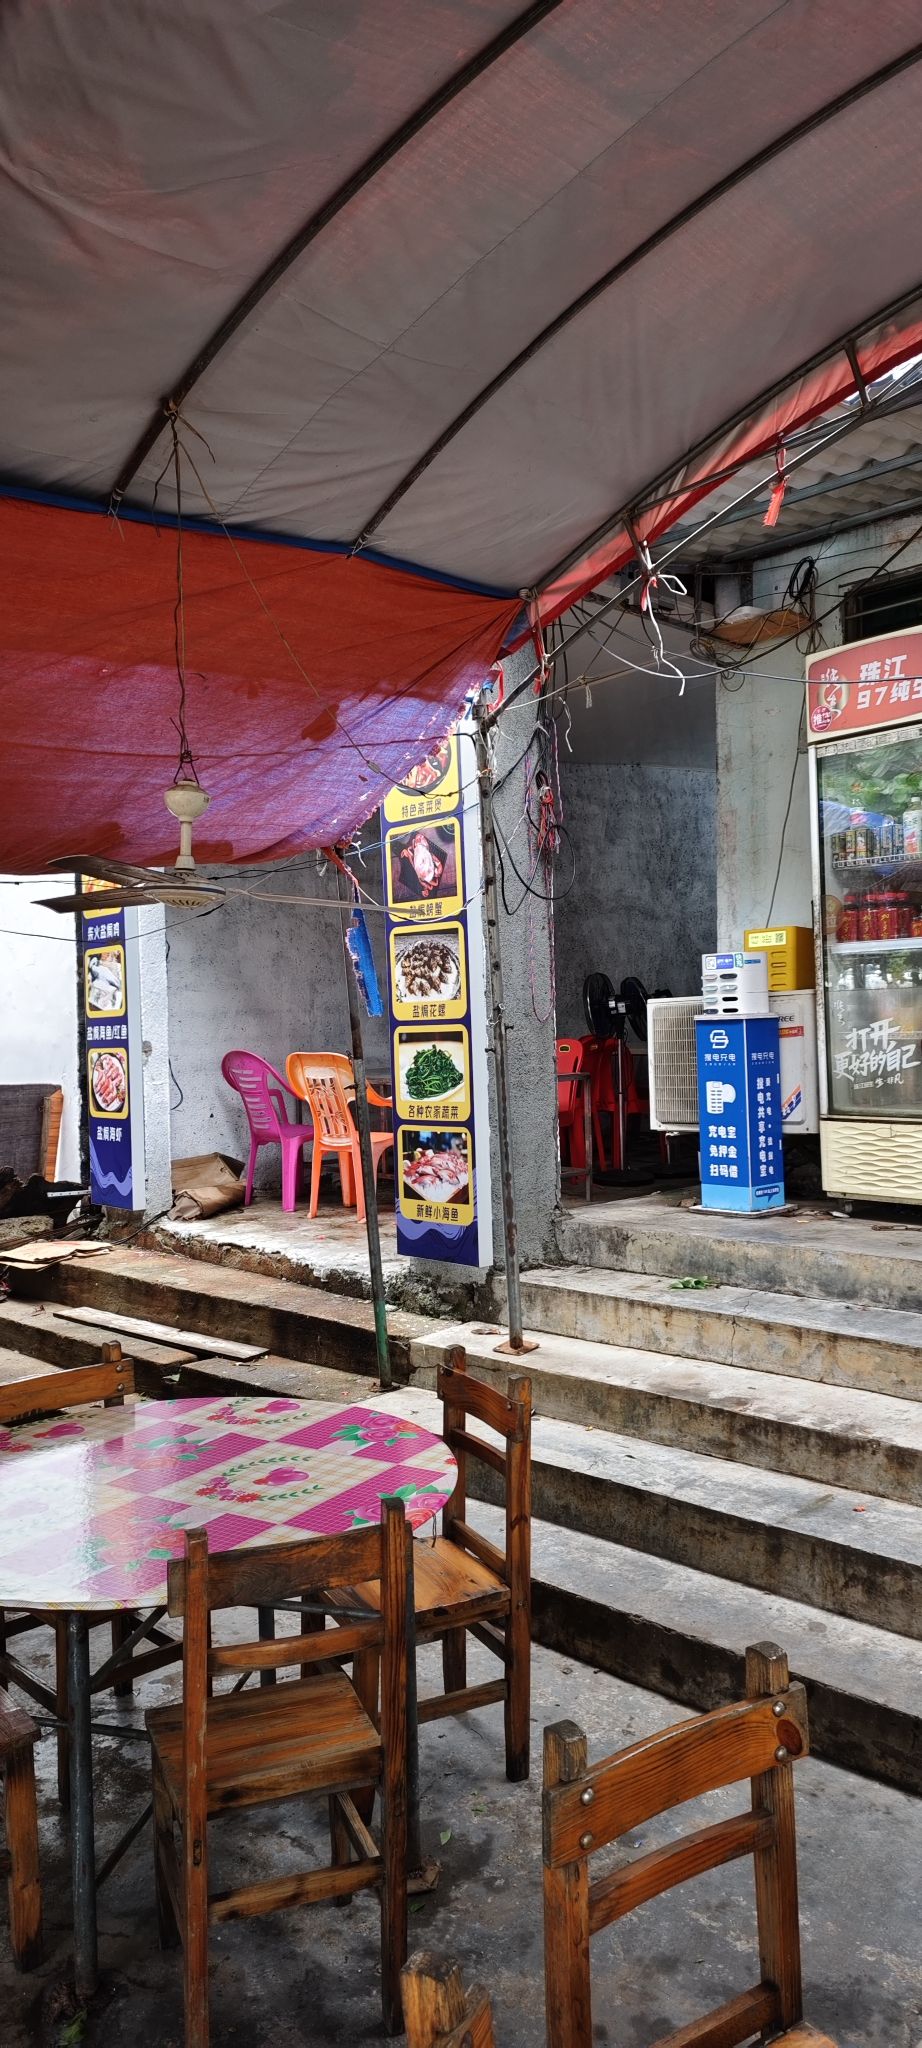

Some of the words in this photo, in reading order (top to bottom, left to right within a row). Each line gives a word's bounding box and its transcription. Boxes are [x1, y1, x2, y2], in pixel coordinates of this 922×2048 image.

[412, 1003, 446, 1018] 盐焗花螺
[845, 1017, 901, 1052] 打开
[704, 1053, 736, 1062] 搜电充电
[834, 1041, 922, 1082] 更好的自己
[408, 1105, 459, 1119] 各种农家蔬菜
[96, 1126, 122, 1142] 盐焗海虾
[708, 1125, 737, 1138] 充电宝
[756, 1077, 768, 1177] 搜电共享充电宝
[709, 1145, 738, 1159] 免押金
[709, 1163, 739, 1178] 扫码借
[416, 1204, 459, 1221] 新鲜小海鱼
